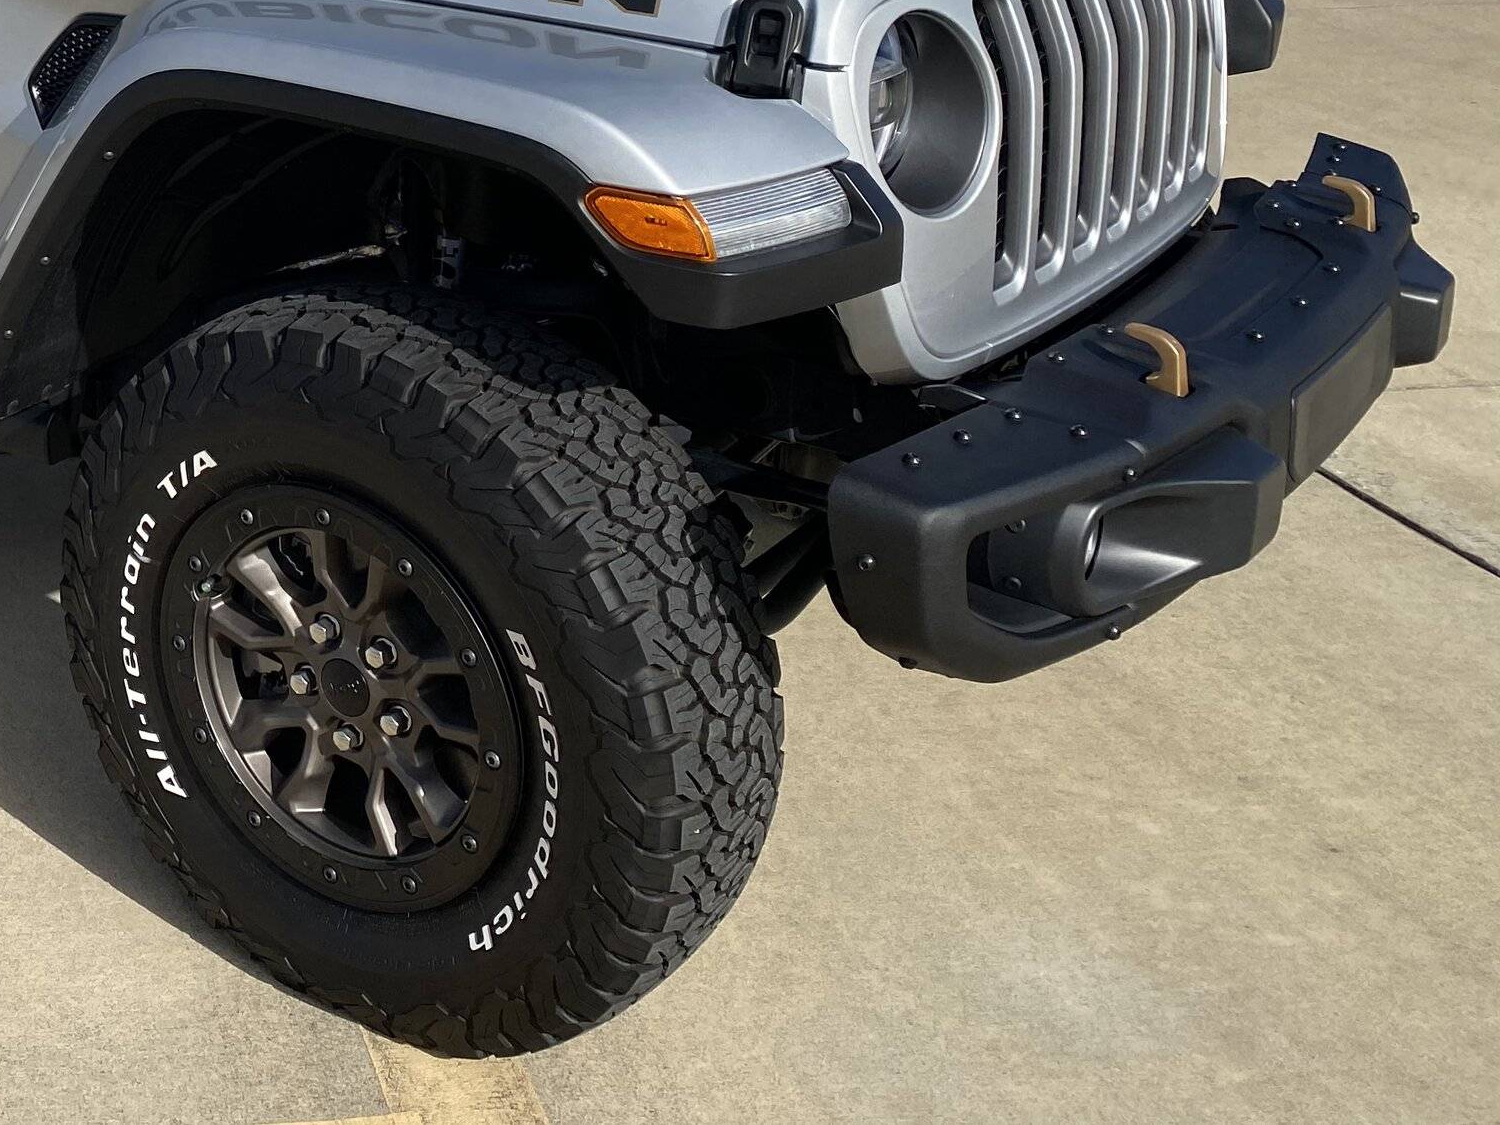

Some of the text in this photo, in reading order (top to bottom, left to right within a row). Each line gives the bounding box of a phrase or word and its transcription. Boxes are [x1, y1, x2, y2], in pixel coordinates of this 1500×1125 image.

[119, 449, 218, 799] All-Terrain T/A
[468, 627, 560, 952] BFGoodrich
